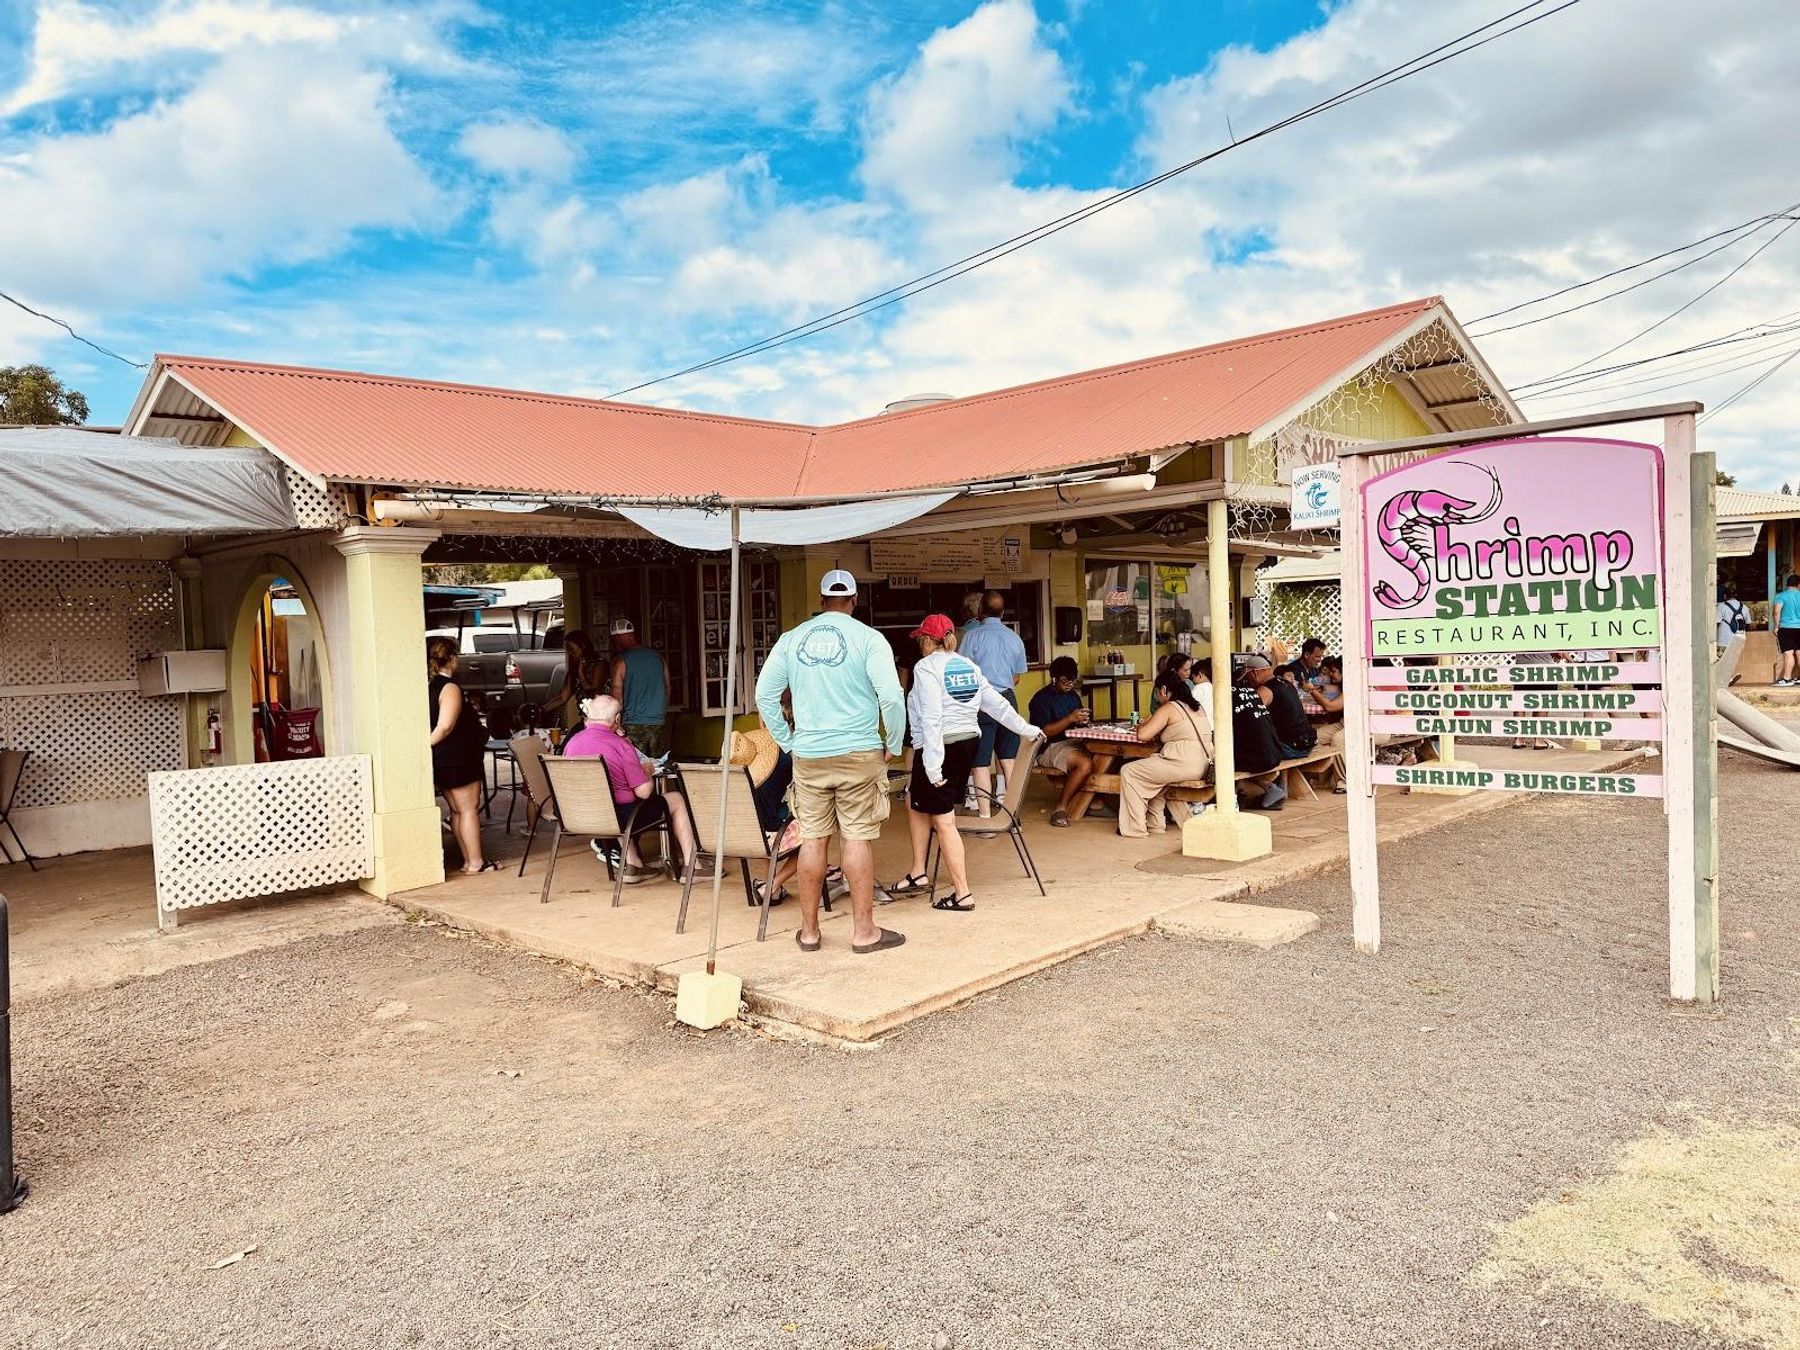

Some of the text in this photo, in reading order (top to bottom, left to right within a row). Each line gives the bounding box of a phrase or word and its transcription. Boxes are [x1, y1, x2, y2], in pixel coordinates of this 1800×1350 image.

[1293, 469, 1341, 489] NOW SERVING
[1373, 490, 1633, 609] Shrimp
[1434, 574, 1656, 620] STATION
[1378, 618, 1653, 646] RESTAURANT, INC.
[950, 672, 977, 687] YETI
[1406, 665, 1619, 683] GARLIC SHRIMP
[1395, 693, 1636, 709] COCONUT SHRIMP
[1416, 718, 1612, 737] CAJUN SHRIMP
[1396, 769, 1636, 794] SHRIMP BURGERS
